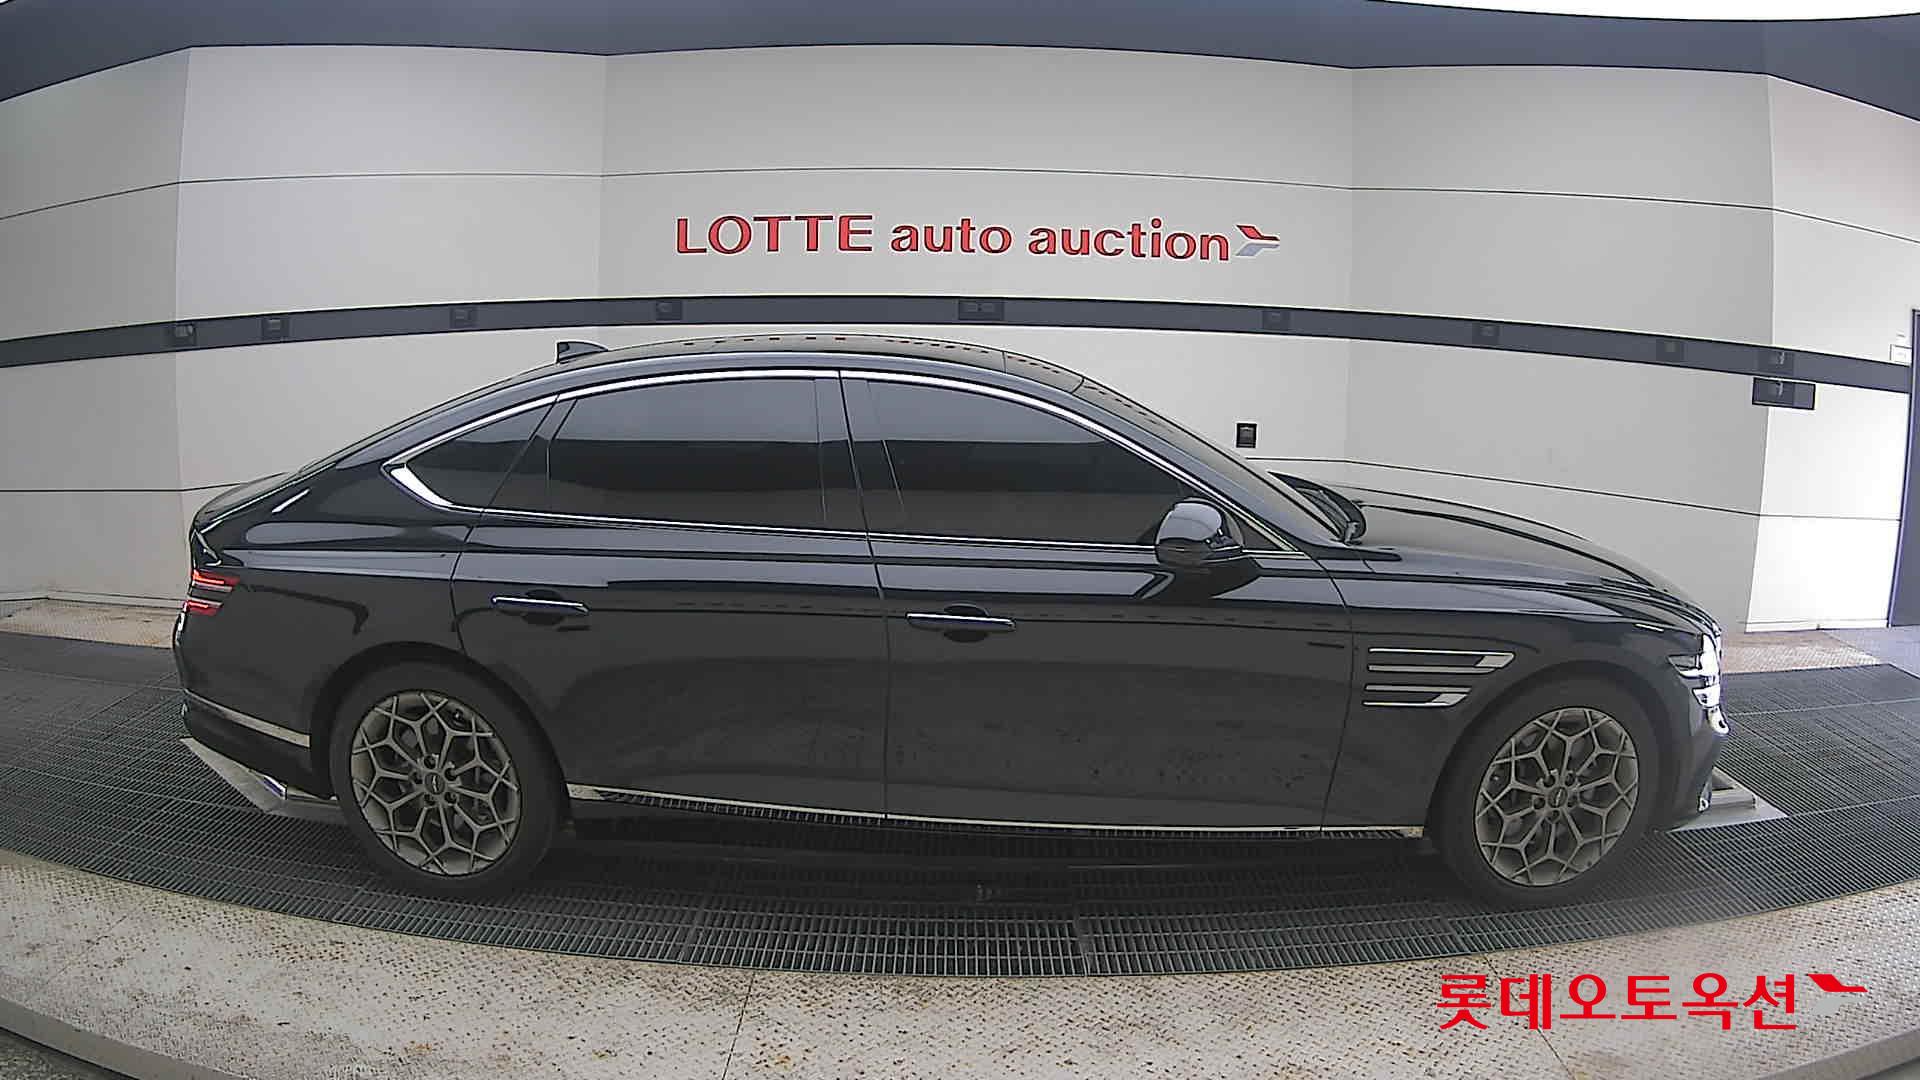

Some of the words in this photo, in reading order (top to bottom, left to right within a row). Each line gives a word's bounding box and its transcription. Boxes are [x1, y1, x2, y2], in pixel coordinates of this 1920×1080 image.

[676, 214, 873, 254] LOTTE
[890, 218, 1013, 254] auto
[1027, 217, 1230, 261] auction
